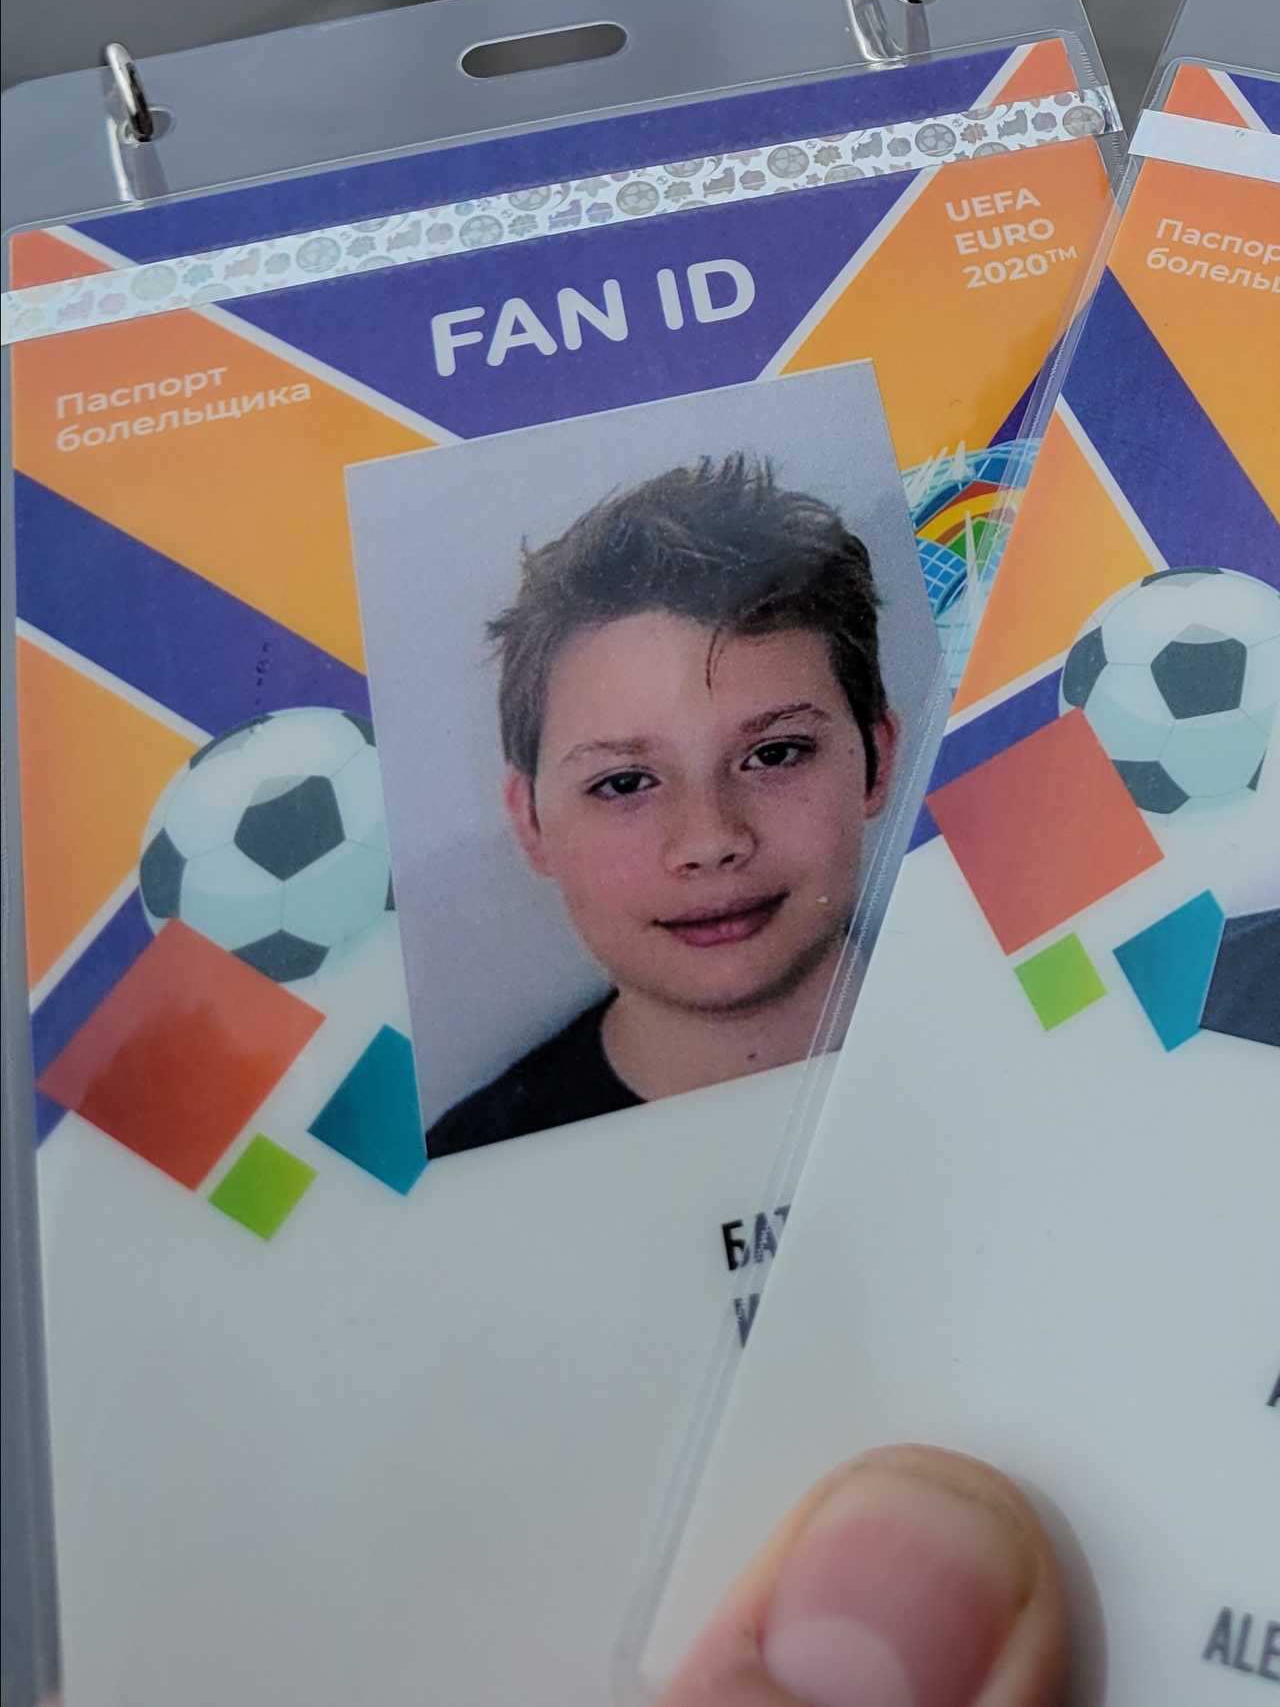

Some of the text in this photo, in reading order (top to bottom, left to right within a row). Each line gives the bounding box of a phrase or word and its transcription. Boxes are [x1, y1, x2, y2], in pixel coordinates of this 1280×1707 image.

[945, 187, 1041, 223] UEFA
[953, 217, 1056, 256] EURO
[430, 258, 757, 377] FAN ID
[56, 366, 228, 418] Паспорт
[56, 381, 311, 454] болельщика
